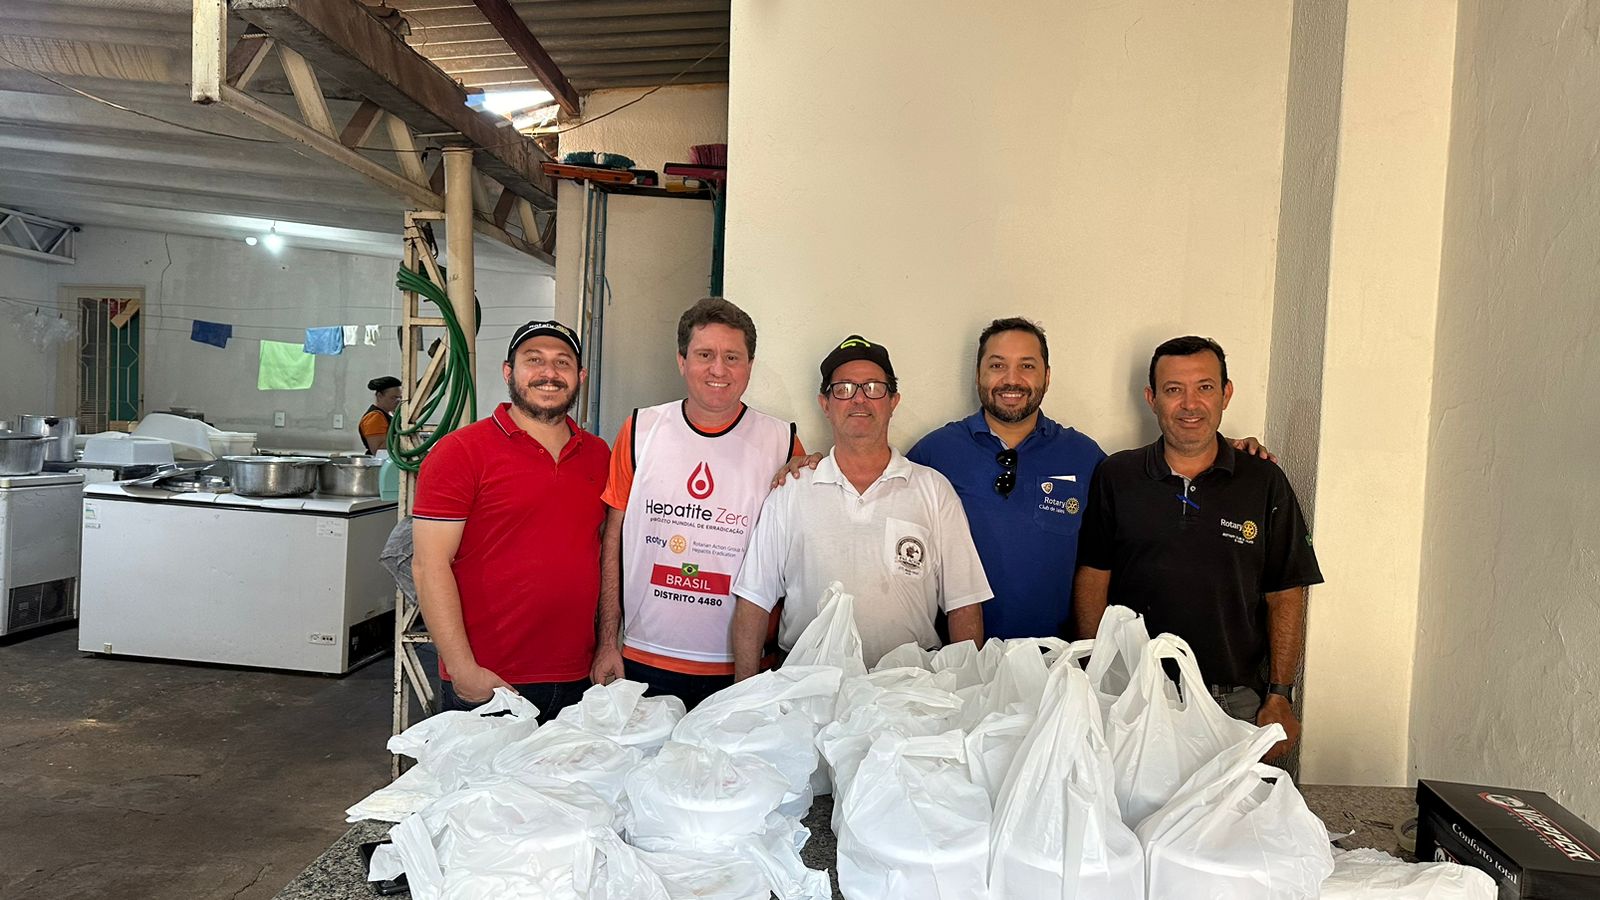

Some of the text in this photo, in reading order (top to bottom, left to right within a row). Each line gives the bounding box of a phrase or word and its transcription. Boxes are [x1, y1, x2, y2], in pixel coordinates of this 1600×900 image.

[1044, 497, 1065, 509] Rotary
[645, 499, 748, 527] Hepatite Zero
[671, 520, 695, 528] MUNDIAL
[1220, 518, 1242, 531] Rotary
[665, 573, 712, 591] BRASIL
[653, 589, 723, 607] DISTRITO 4480
[1452, 823, 1518, 885] Conforto total
